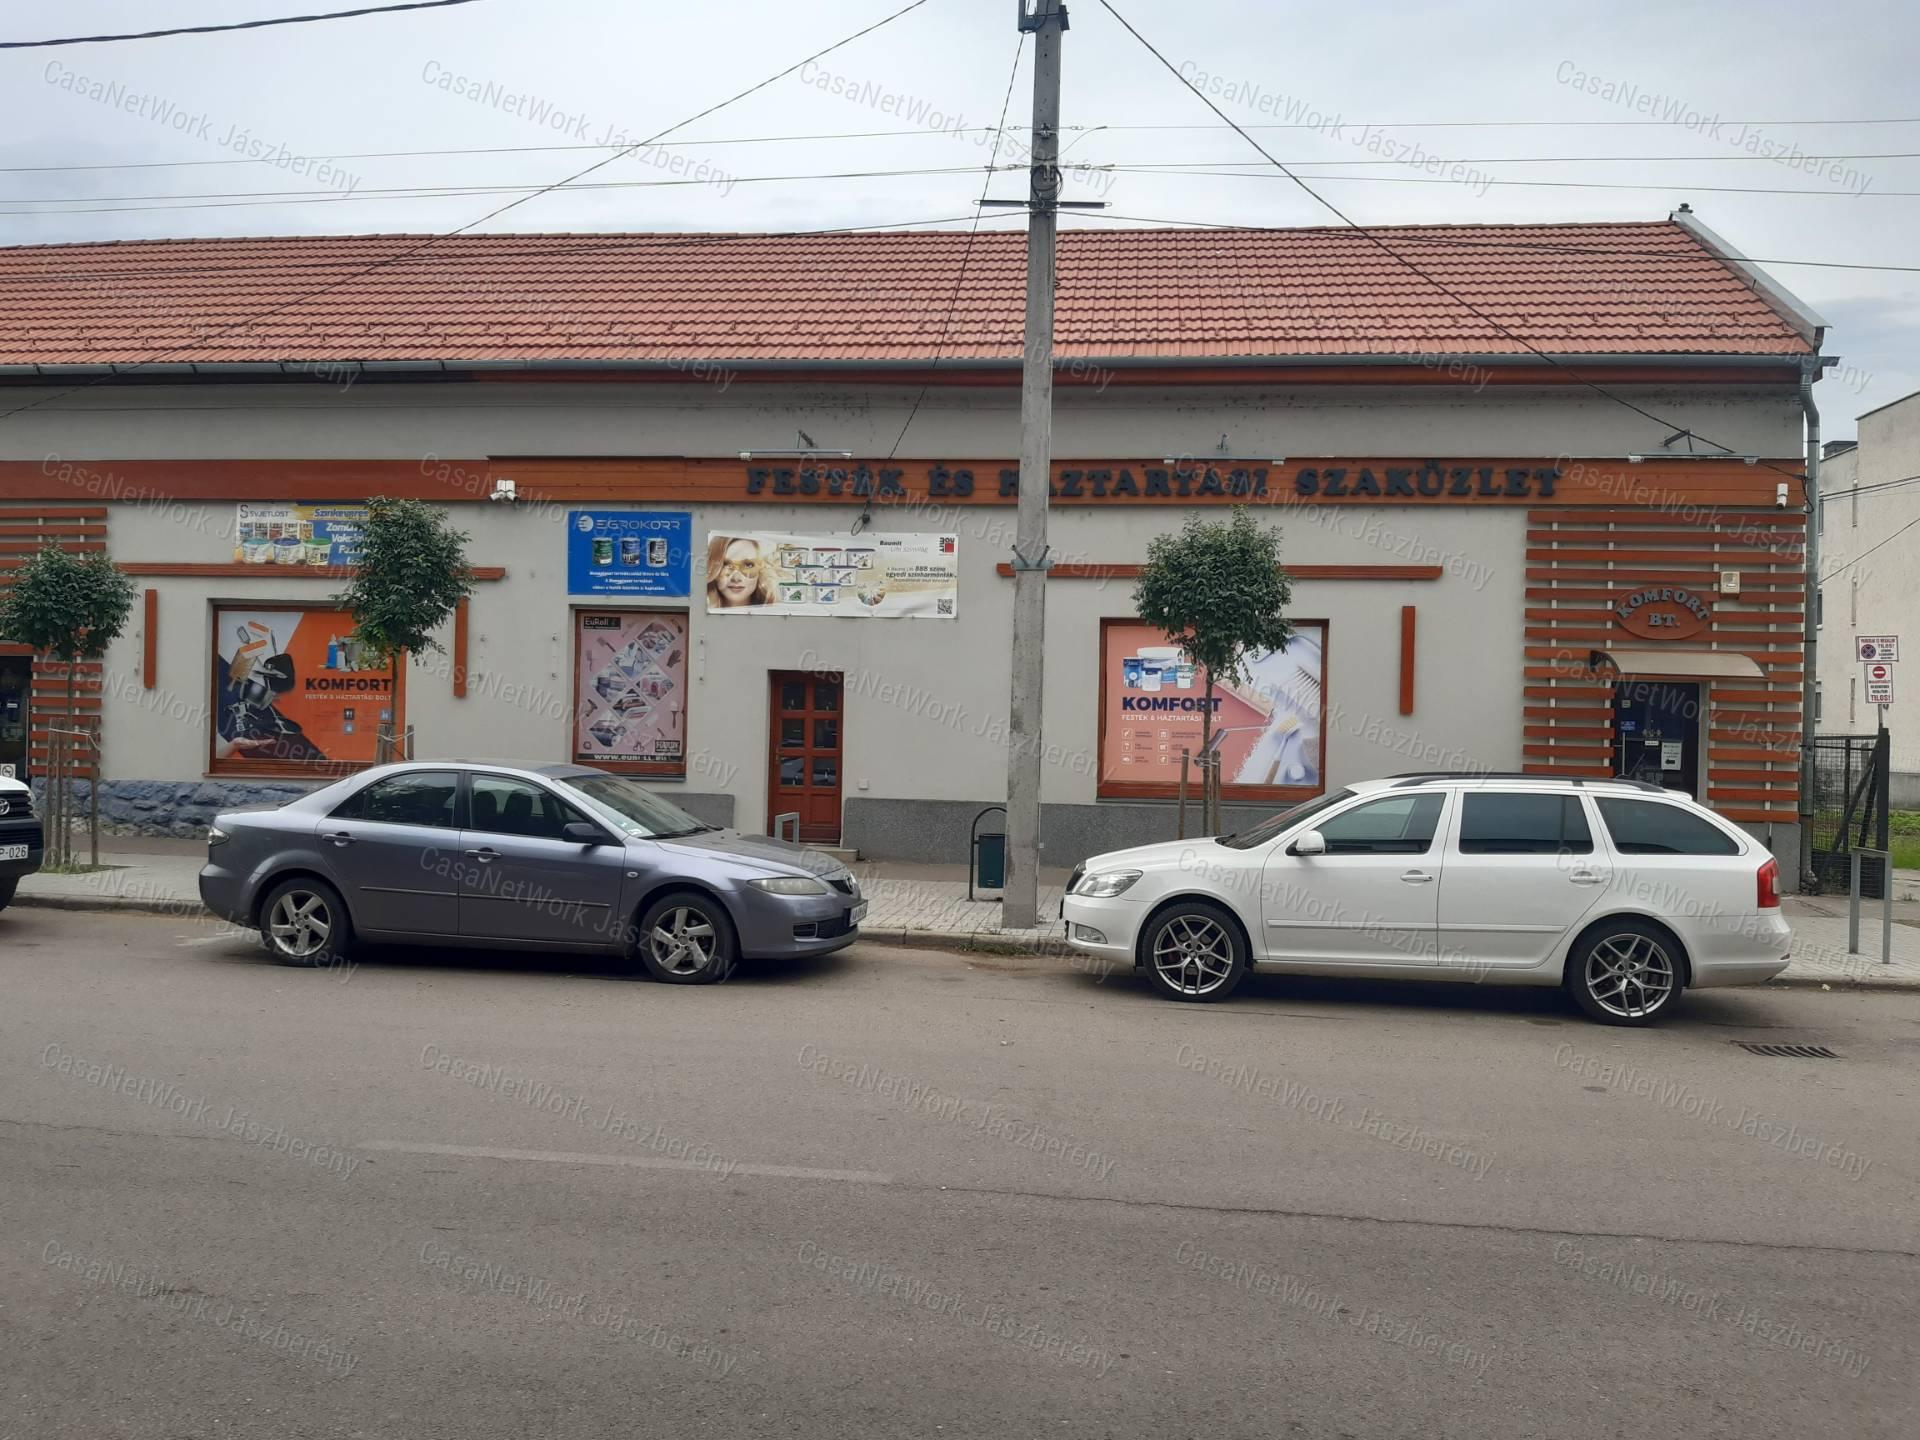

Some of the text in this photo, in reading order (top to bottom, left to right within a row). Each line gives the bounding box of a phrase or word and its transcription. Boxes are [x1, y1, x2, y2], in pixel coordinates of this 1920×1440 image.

[746, 459, 1561, 498] FESTÉK ÉS HZTARTÁSI SZAKÜZLET
[1616, 587, 1709, 619] KOMFORT
[1648, 613, 1681, 627] BT.
[305, 678, 392, 691] KOMFORT
[1122, 697, 1222, 712] KOMFORT
[1157, 714, 1202, 722] HÁZTARTÁSI
